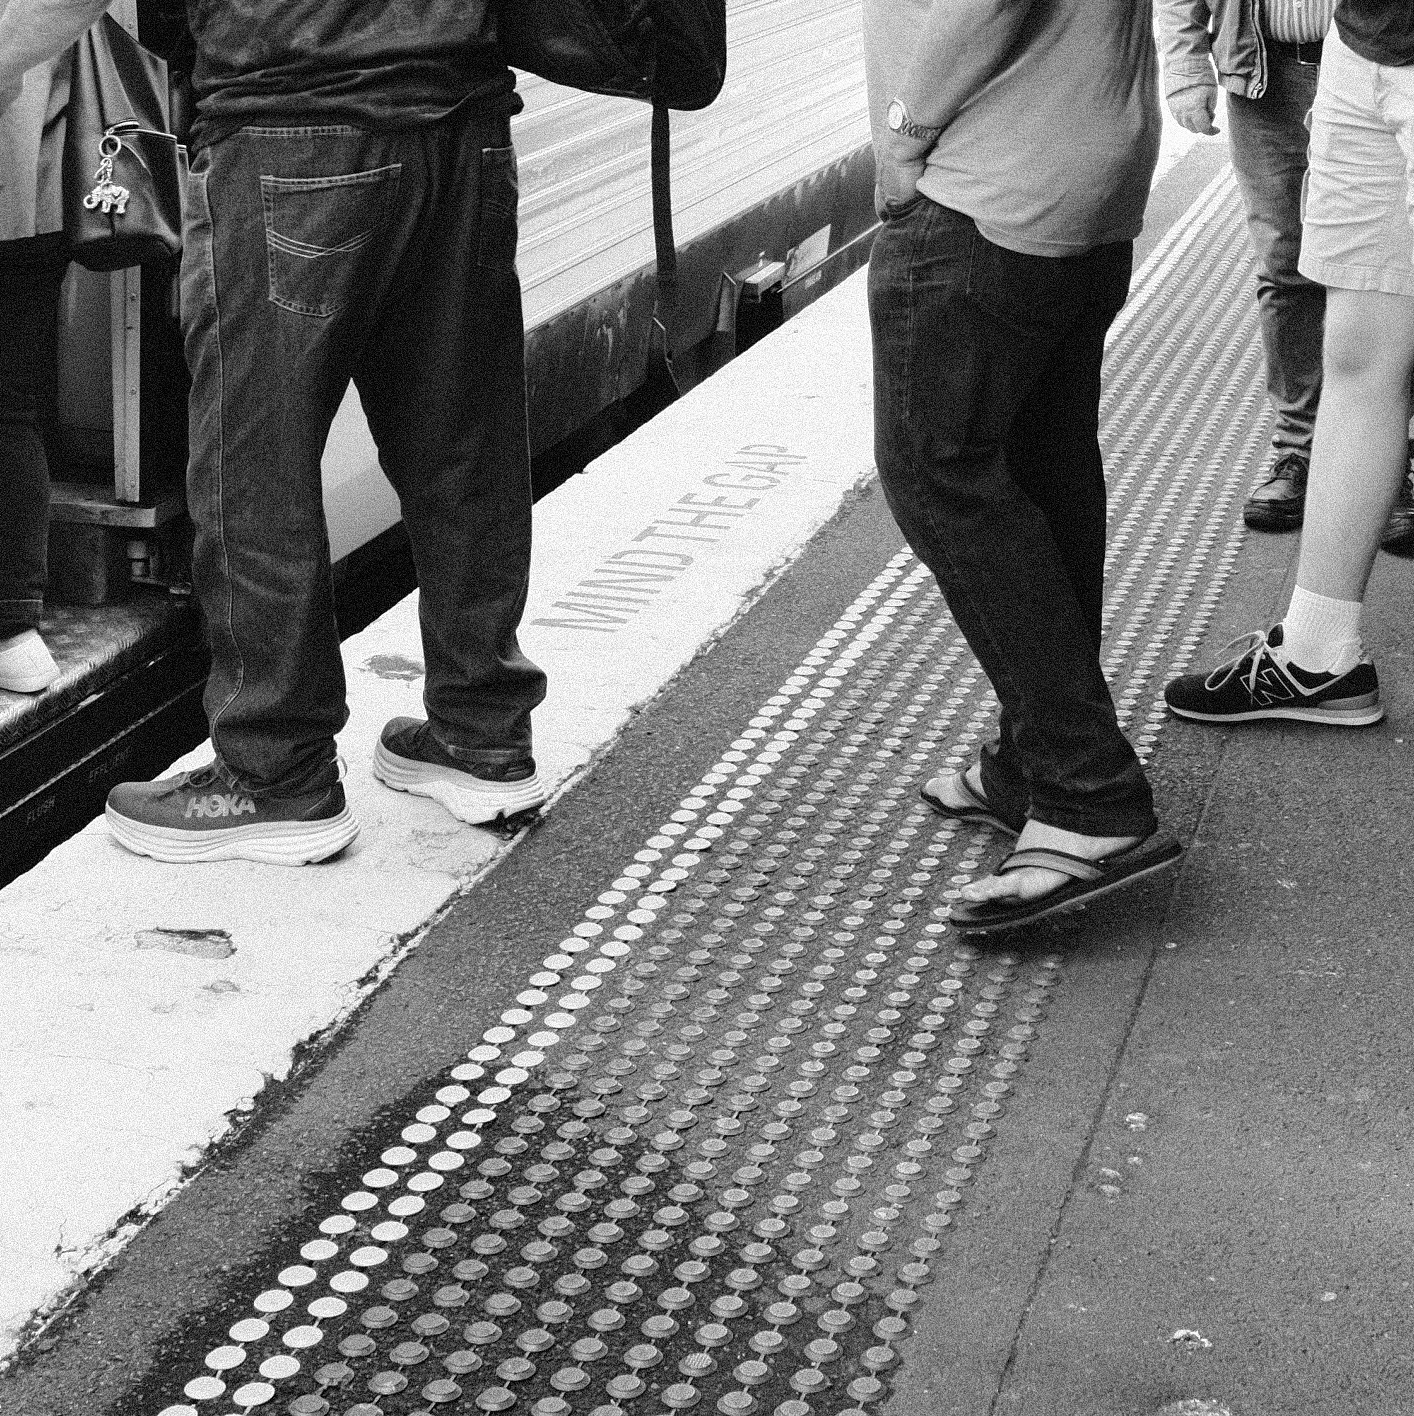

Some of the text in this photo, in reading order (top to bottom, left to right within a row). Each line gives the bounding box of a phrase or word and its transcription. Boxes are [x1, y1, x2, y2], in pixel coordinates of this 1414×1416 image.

[530, 443, 808, 633] MIND THE GAP
[185, 793, 257, 818] HOKA
